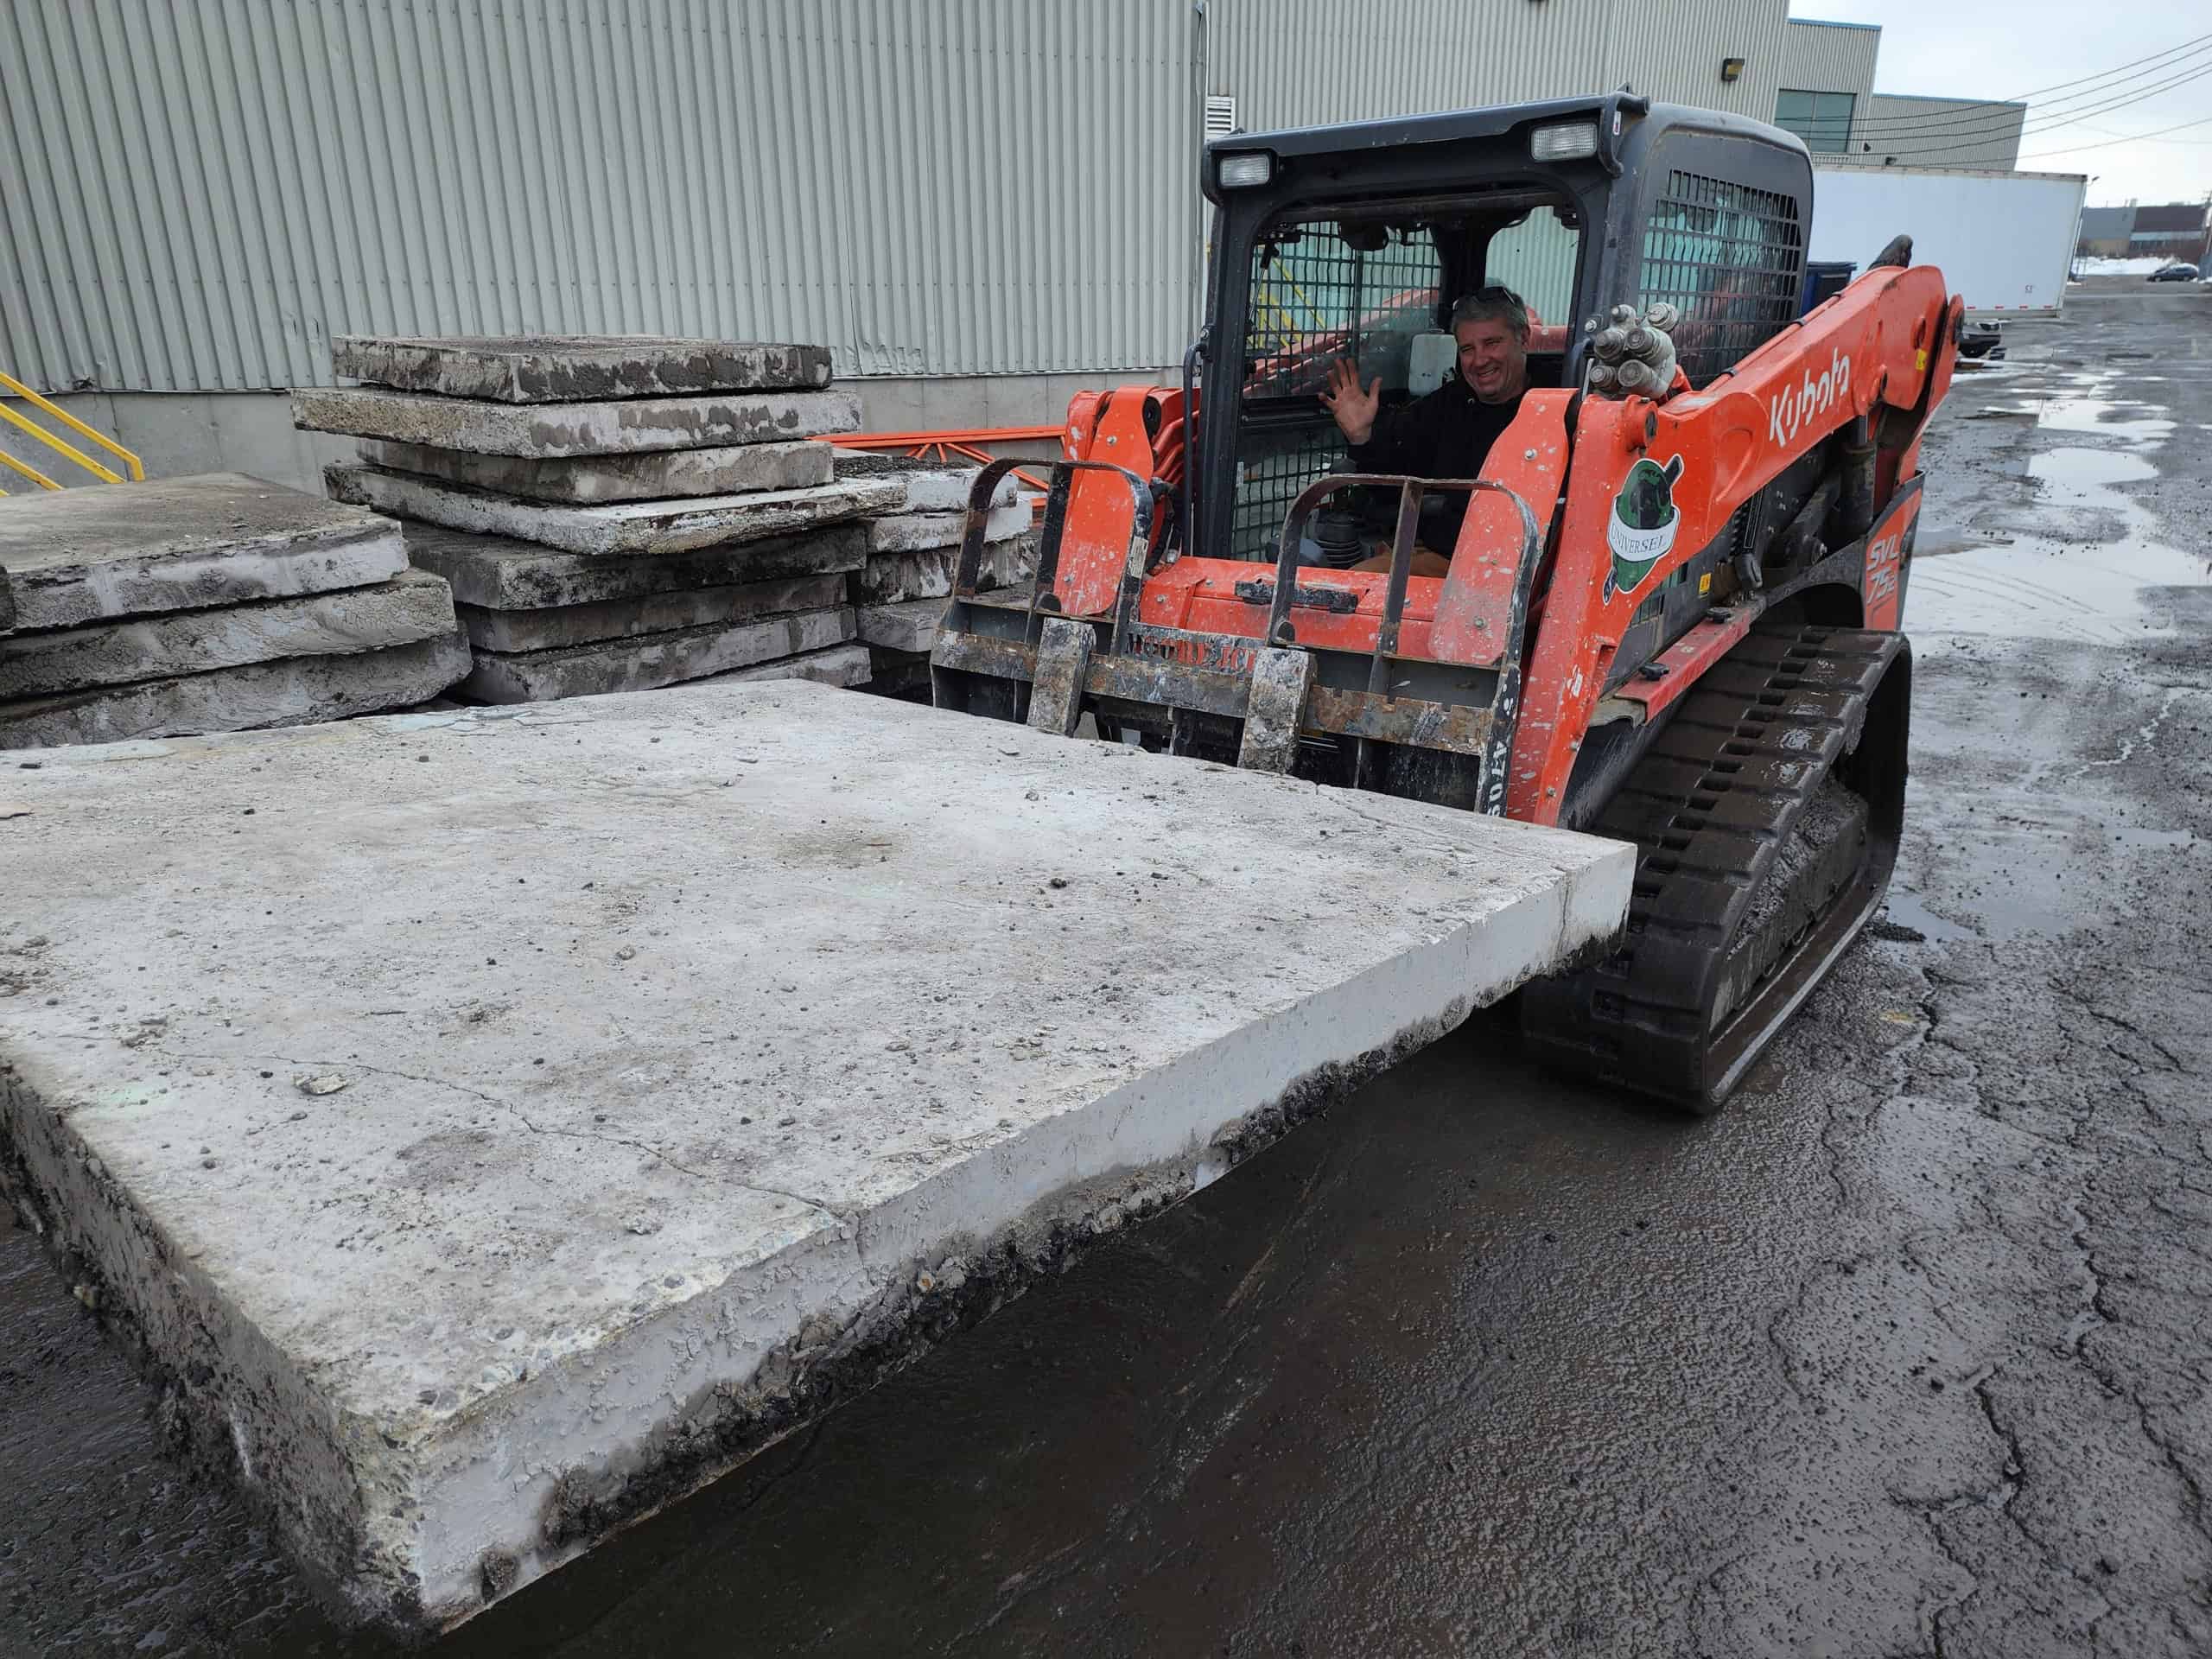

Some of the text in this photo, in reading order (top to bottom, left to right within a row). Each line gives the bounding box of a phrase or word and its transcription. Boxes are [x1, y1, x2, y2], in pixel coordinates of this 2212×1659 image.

[1769, 346, 1850, 448] Kubota
[1611, 524, 1667, 554] UNIVERSEL
[1866, 534, 1898, 570] SVL
